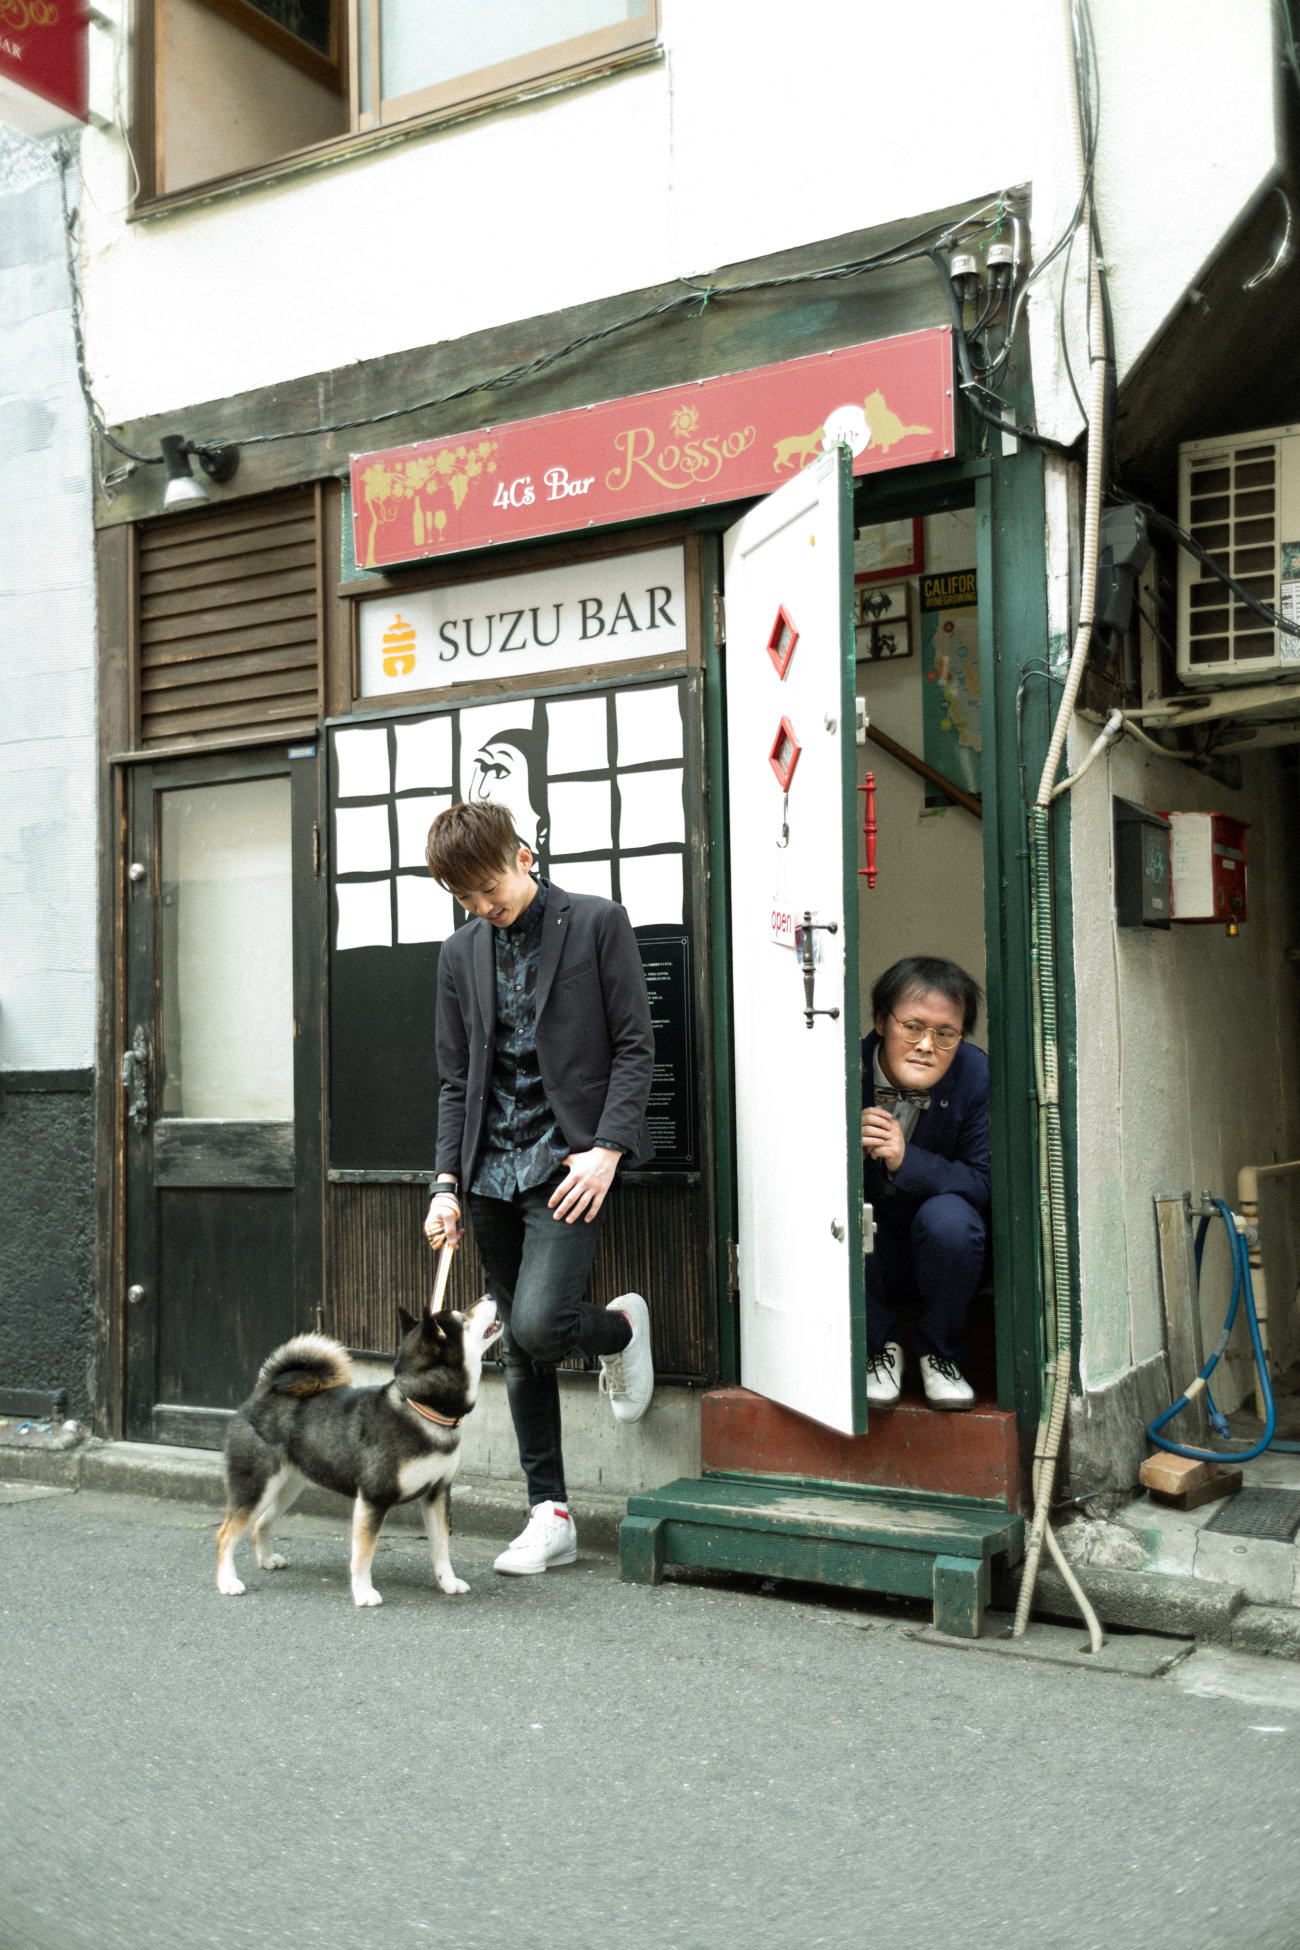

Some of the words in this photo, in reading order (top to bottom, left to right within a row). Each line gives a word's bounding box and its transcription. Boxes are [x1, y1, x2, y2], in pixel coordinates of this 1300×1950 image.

[0, 37, 23, 62] AR
[605, 425, 756, 491] Rosso
[493, 476, 536, 510] 4C's
[543, 467, 596, 502] Bar
[438, 603, 564, 662] SUZU
[577, 586, 677, 641] BAR
[771, 910, 792, 938] open
